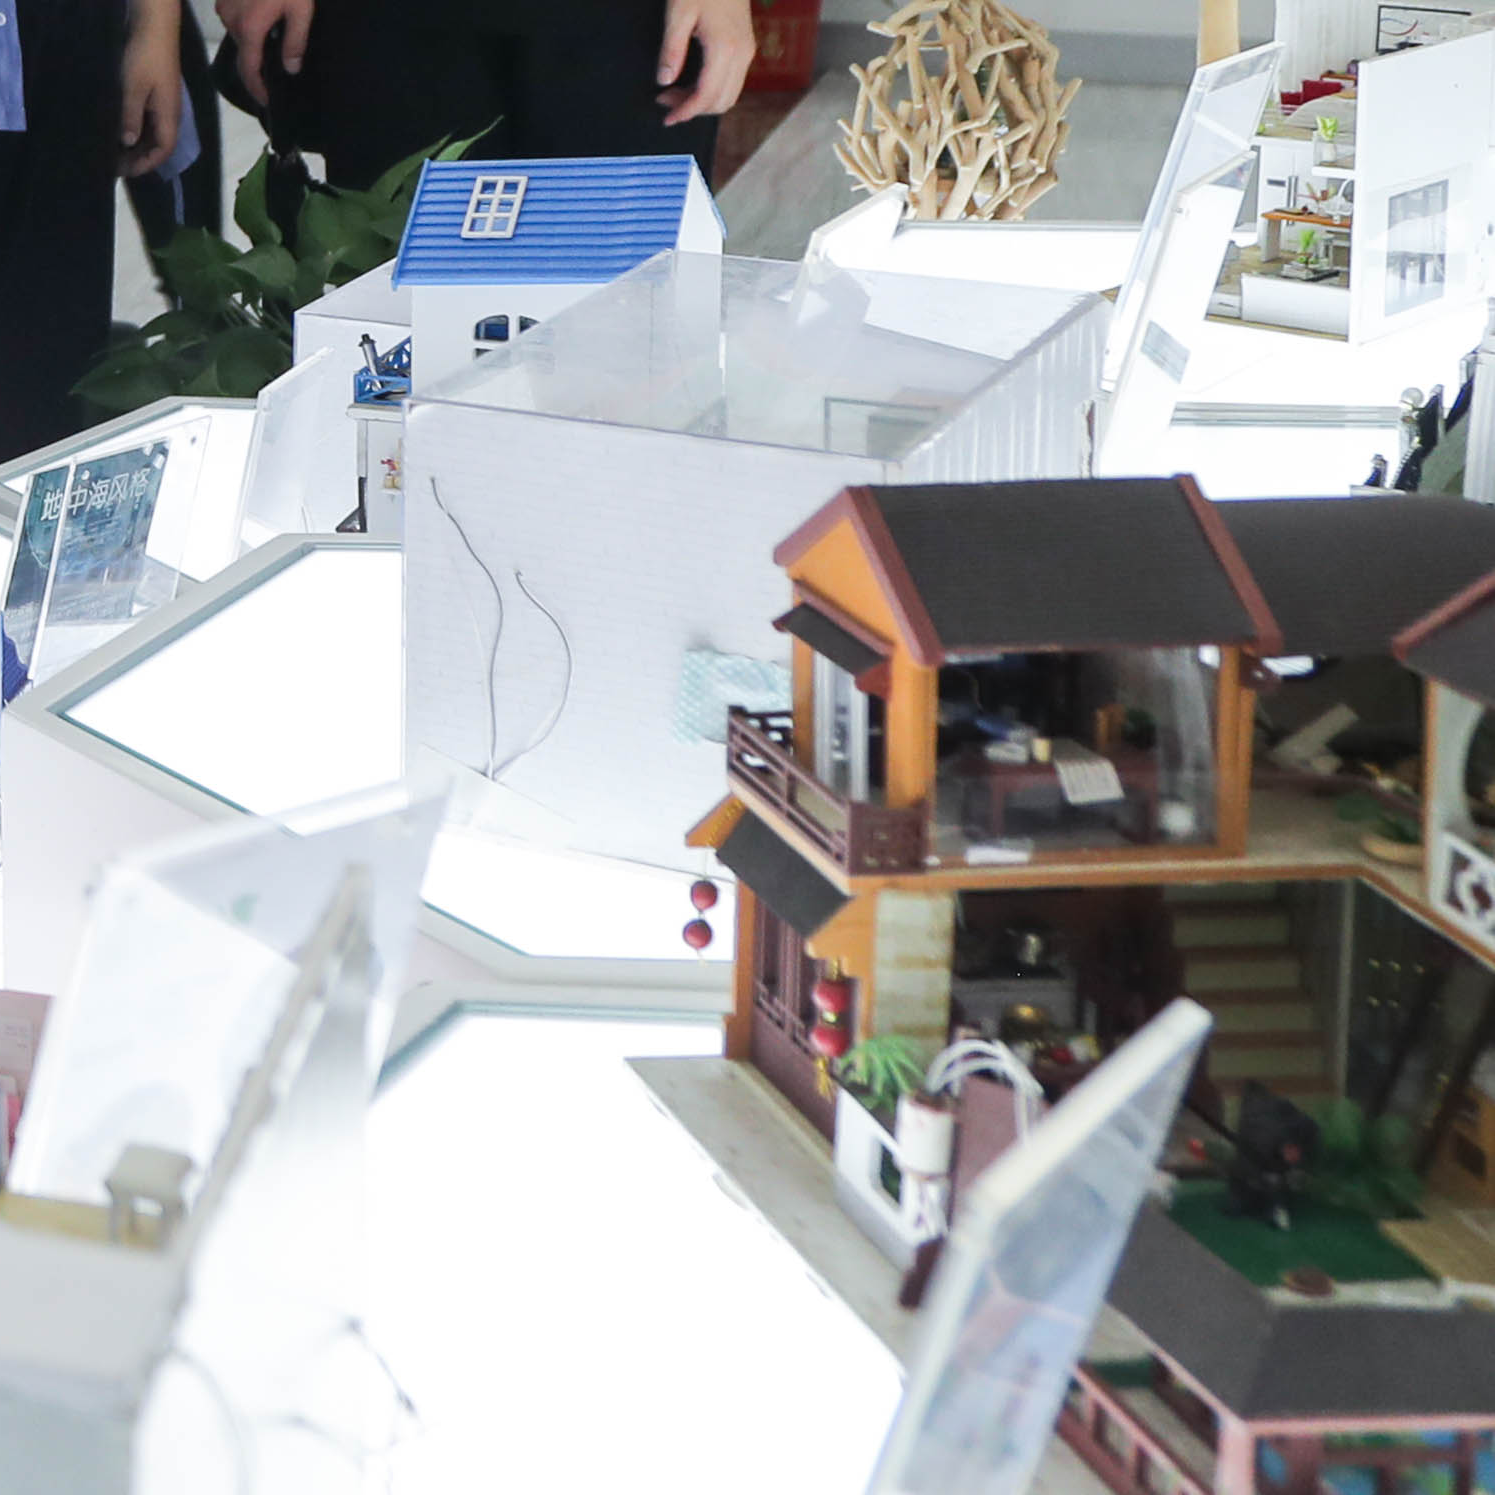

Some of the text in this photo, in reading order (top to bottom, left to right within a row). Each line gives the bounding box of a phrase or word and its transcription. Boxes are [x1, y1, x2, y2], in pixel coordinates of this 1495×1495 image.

[40, 467, 152, 522] 地中海风格
